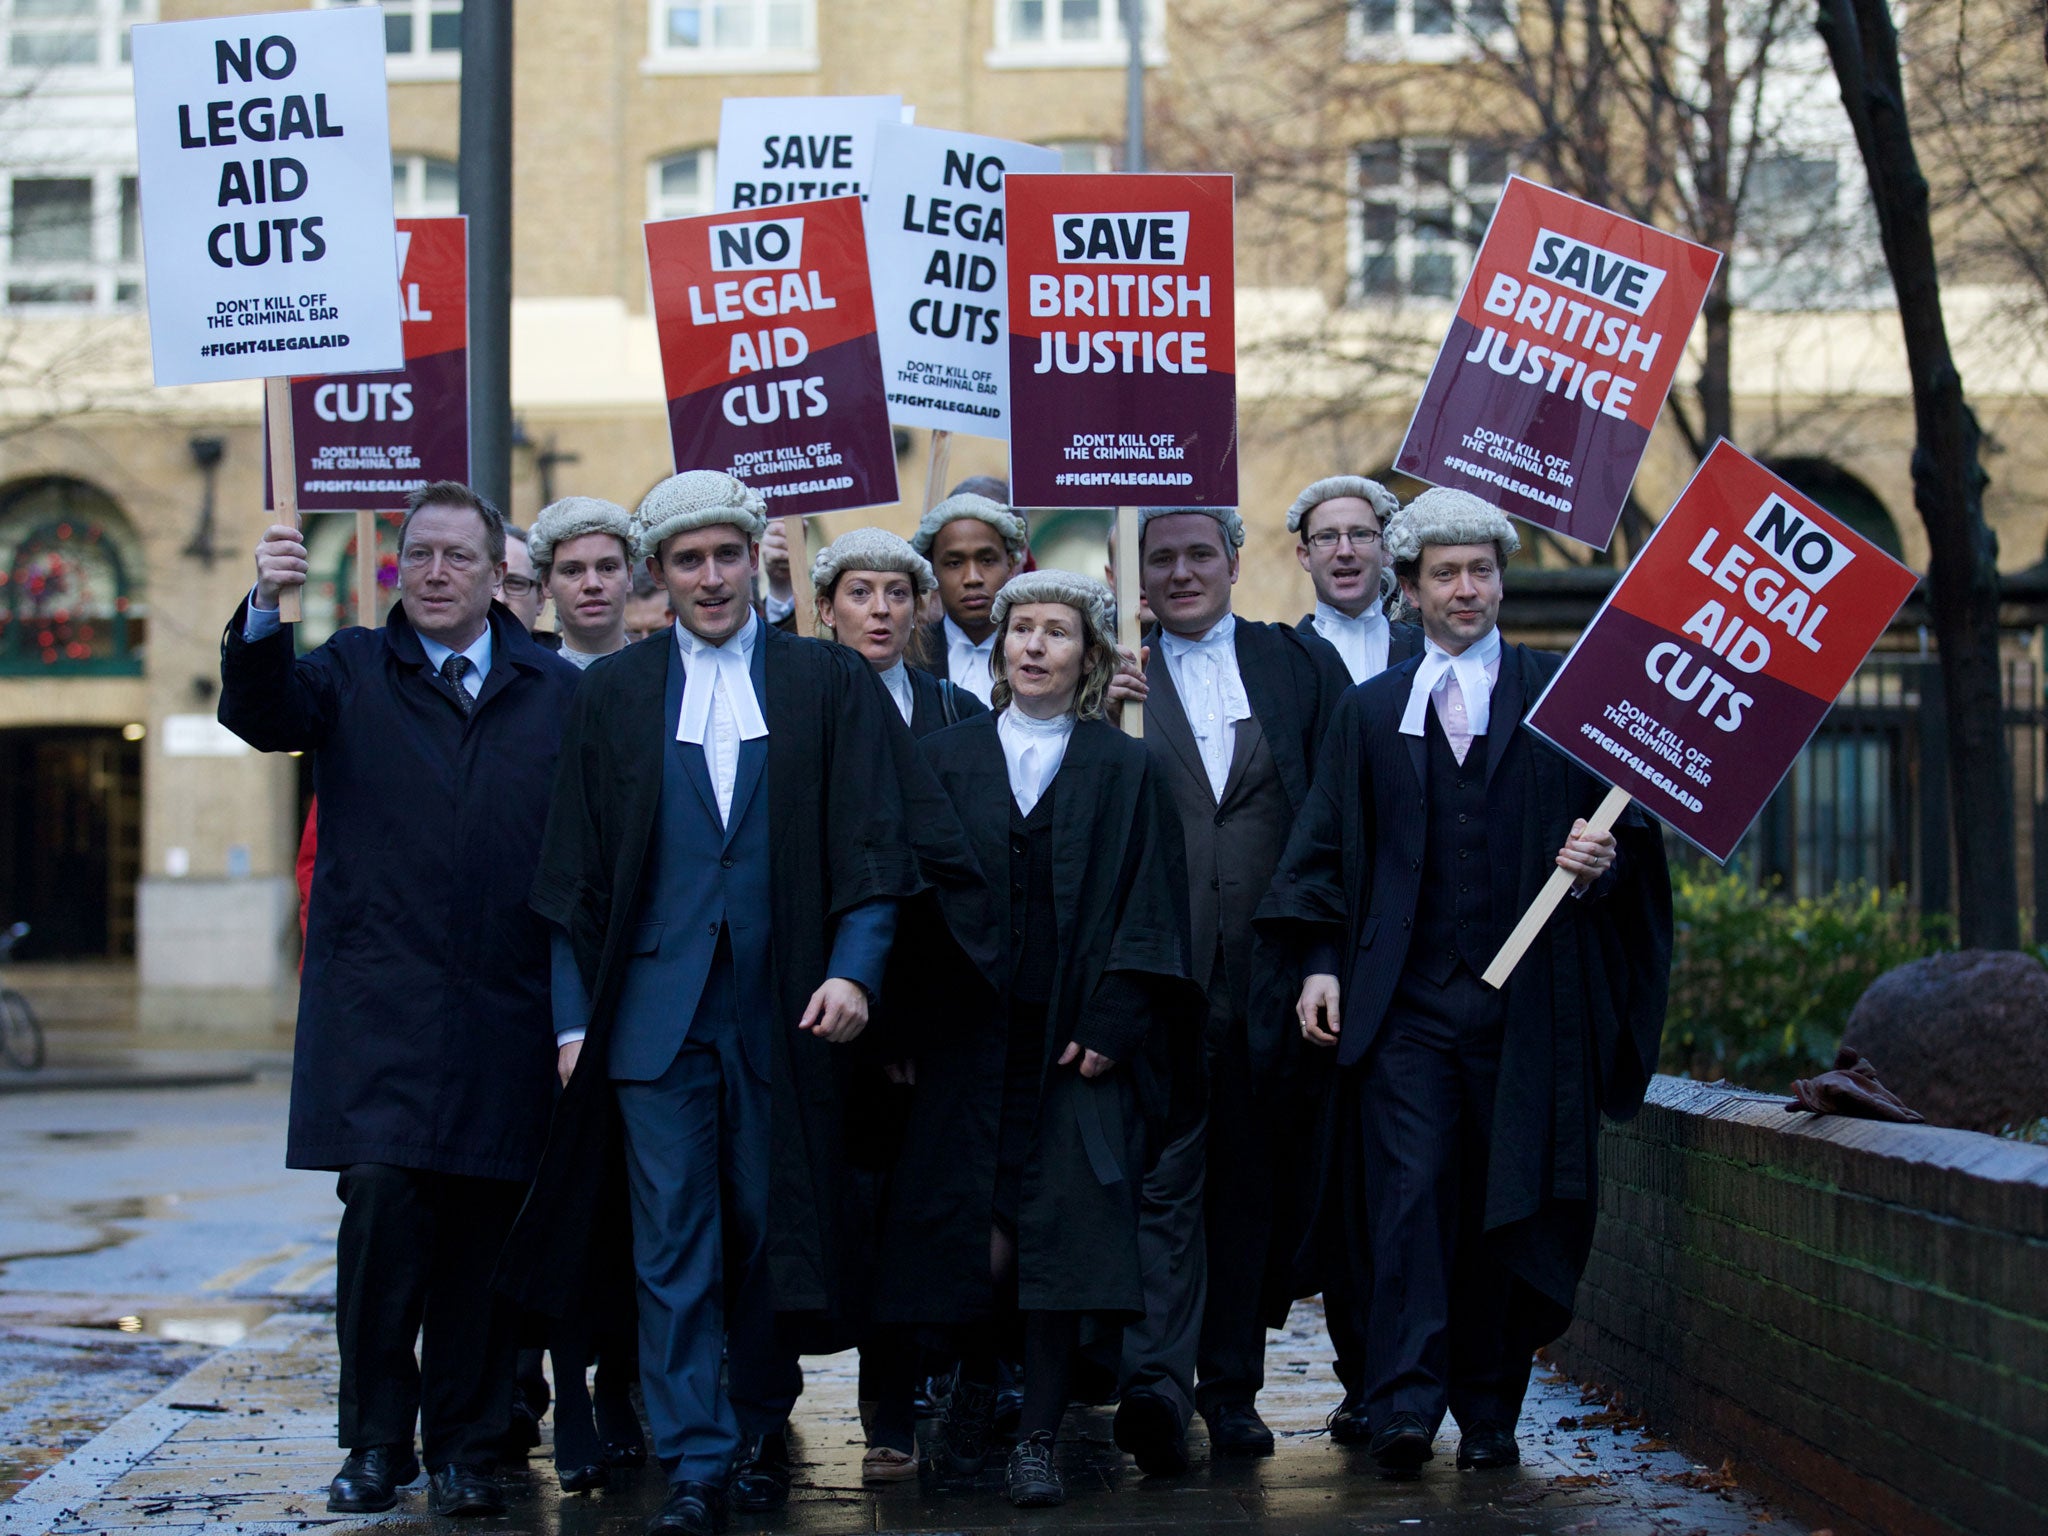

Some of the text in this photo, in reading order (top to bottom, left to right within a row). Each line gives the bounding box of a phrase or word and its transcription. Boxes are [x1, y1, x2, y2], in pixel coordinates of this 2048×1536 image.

[215, 35, 297, 84] NO
[178, 93, 344, 149] LEGAL
[763, 135, 853, 169] SAVE
[943, 149, 1006, 193] NO
[218, 157, 308, 207] AID
[733, 182, 868, 209] BRIT
[208, 216, 326, 268] CUTS
[903, 194, 1004, 246] LEGA
[1062, 218, 1176, 260] SAVE
[718, 223, 790, 268] NO
[924, 249, 997, 293] AID
[1534, 237, 1649, 309] SAVE
[207, 307, 339, 329] THE CRIMINAL BAR
[216, 293, 327, 314] DON'T KILL OFF
[688, 270, 837, 326] LEGAL
[1029, 274, 1211, 318] BRITISH
[909, 298, 1000, 345] CUTS
[1483, 272, 1663, 372] BRITISH
[201, 334, 350, 357] #FIGHT4LEGALAID
[729, 327, 809, 374] AID
[1033, 330, 1208, 374] JUSTICE
[897, 371, 998, 395] THE CRIMINAL BAR
[907, 360, 992, 382] DON'T KILL OFF
[1465, 326, 1638, 421] JUSTICE
[314, 383, 414, 422] CUTS
[722, 376, 829, 426] CUTS
[887, 393, 1001, 419] #FIGHT4LEGALAID
[311, 457, 421, 469] THE CRIMINAL BAR
[319, 446, 412, 458] DON'T KILL OFF
[733, 442, 832, 466] DON'T KILL OFF
[1063, 447, 1185, 460] THE CRIMINAL BAR
[1073, 434, 1175, 447] DON'T KILL OFF
[1461, 434, 1574, 488] THE CRIMINAL BAR
[1473, 426, 1571, 471] DON'T KILL OFF
[726, 453, 842, 478] THE CRIMINAL BAR
[757, 476, 854, 499] T4LEGALAID
[1055, 473, 1193, 486] #FIGHT4LEGALAID
[1443, 455, 1573, 513] #FIGHT4LEGALAID
[1754, 502, 1833, 575] NO
[1687, 527, 1829, 654] LEGAL
[1681, 599, 1771, 674] AID
[1645, 641, 1754, 733] CUTS
[1602, 704, 1712, 788] THE CRIMINAL BAR
[1618, 699, 1713, 769] DON'T KILL OFF
[1580, 722, 1704, 813] #FIGHT4LEGALAID
